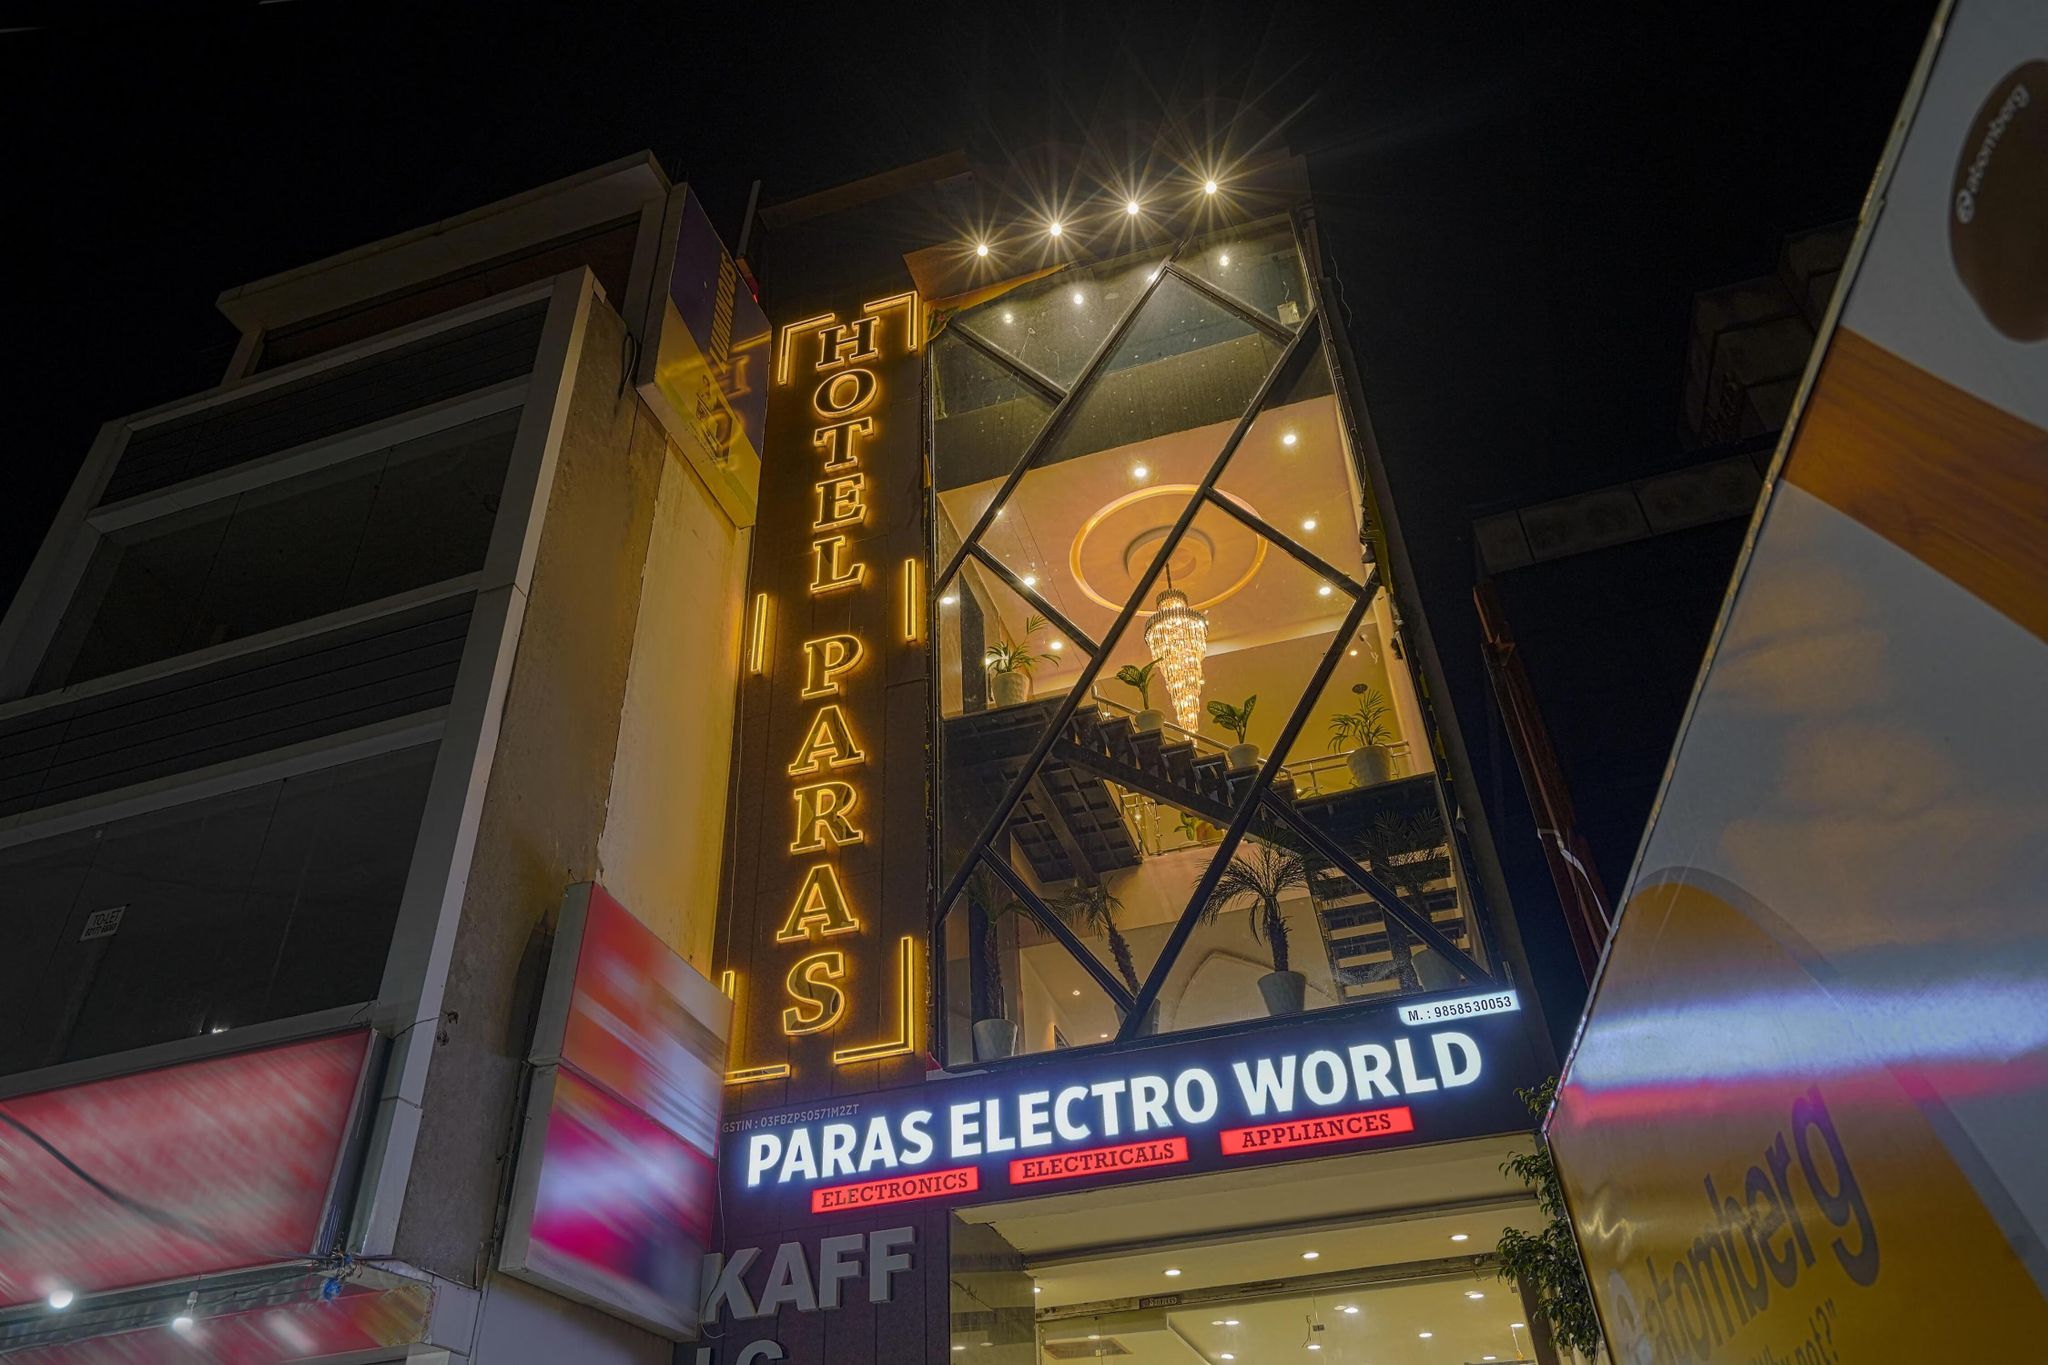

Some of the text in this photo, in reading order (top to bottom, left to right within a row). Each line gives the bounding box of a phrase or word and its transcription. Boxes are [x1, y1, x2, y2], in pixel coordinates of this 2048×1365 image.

[1966, 82, 2031, 195] atomberg
[709, 251, 738, 374] LUMINOUS
[776, 315, 881, 1036] HOTEL PARAS
[1434, 995, 1513, 1019] 9858530053
[722, 1118, 753, 1135] GSTIN
[747, 1031, 1483, 1187] PARAS ELECTRO WORLD
[1241, 1112, 1393, 1149] APPLIANCES
[821, 1172, 969, 1208] ELECTRONICS
[1022, 1143, 1175, 1180] ELECTRICALS
[701, 1226, 915, 1324] KAFF
